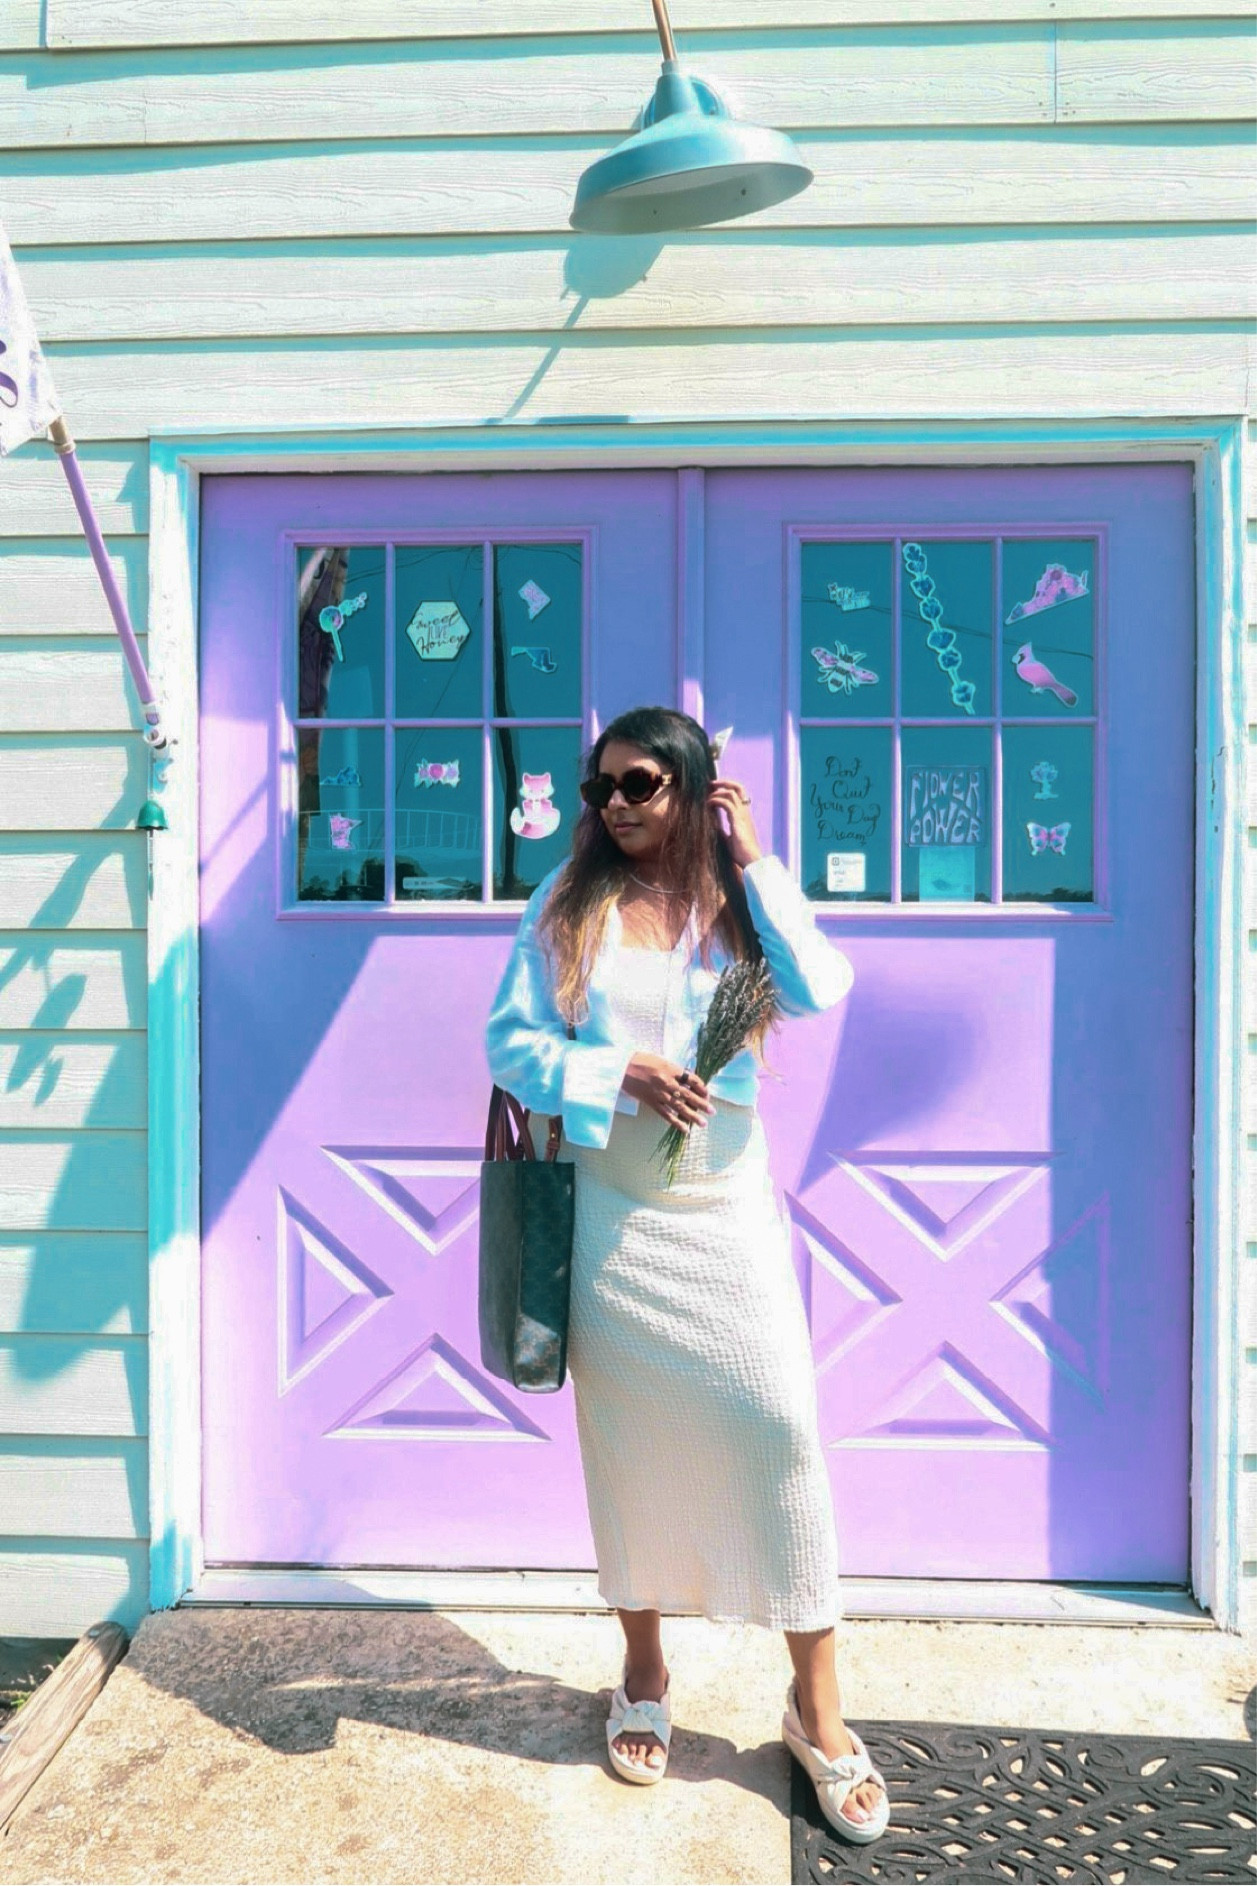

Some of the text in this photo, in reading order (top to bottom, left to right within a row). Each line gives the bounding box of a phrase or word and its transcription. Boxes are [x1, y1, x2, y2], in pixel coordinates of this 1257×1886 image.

[416, 634, 464, 656] Honey
[833, 776, 871, 800] Quit
[810, 783, 881, 837] Your Day
[909, 800, 981, 843] POWER
[817, 819, 866, 845] Dream
